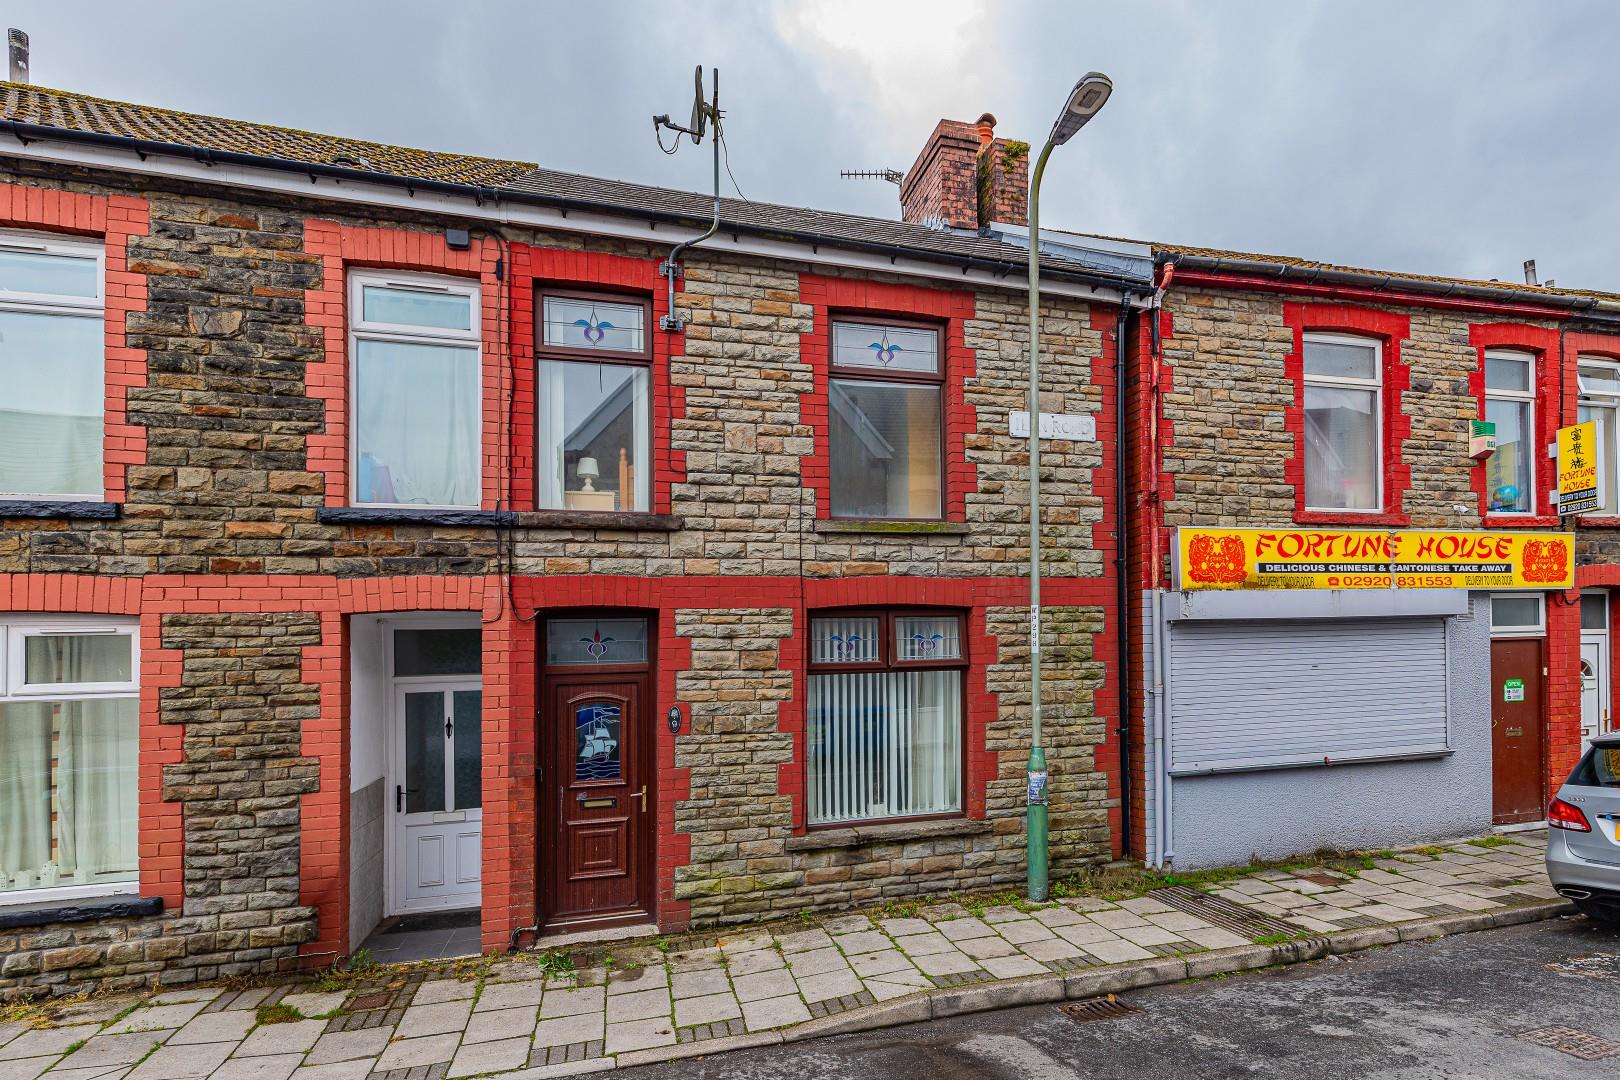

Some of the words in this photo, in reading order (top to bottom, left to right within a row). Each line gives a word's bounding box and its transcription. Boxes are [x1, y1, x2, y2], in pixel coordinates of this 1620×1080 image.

[1559, 467, 1596, 482] FORTUNE
[1564, 479, 1591, 491] HOUSE
[1255, 533, 1402, 559] FORTUNE
[1416, 535, 1513, 560] HOUSE
[1265, 564, 1326, 572] DELICIOUS
[1328, 564, 1376, 572] CHINESE
[1378, 564, 1387, 572] &
[1389, 564, 1450, 572] CANTONESE
[1343, 576, 1392, 586] 02920
[1397, 576, 1453, 586] 831553
[1465, 575, 1484, 586] DELIVERY
[1490, 575, 1502, 586] YOUR
[1502, 575, 1514, 586] DOOR
